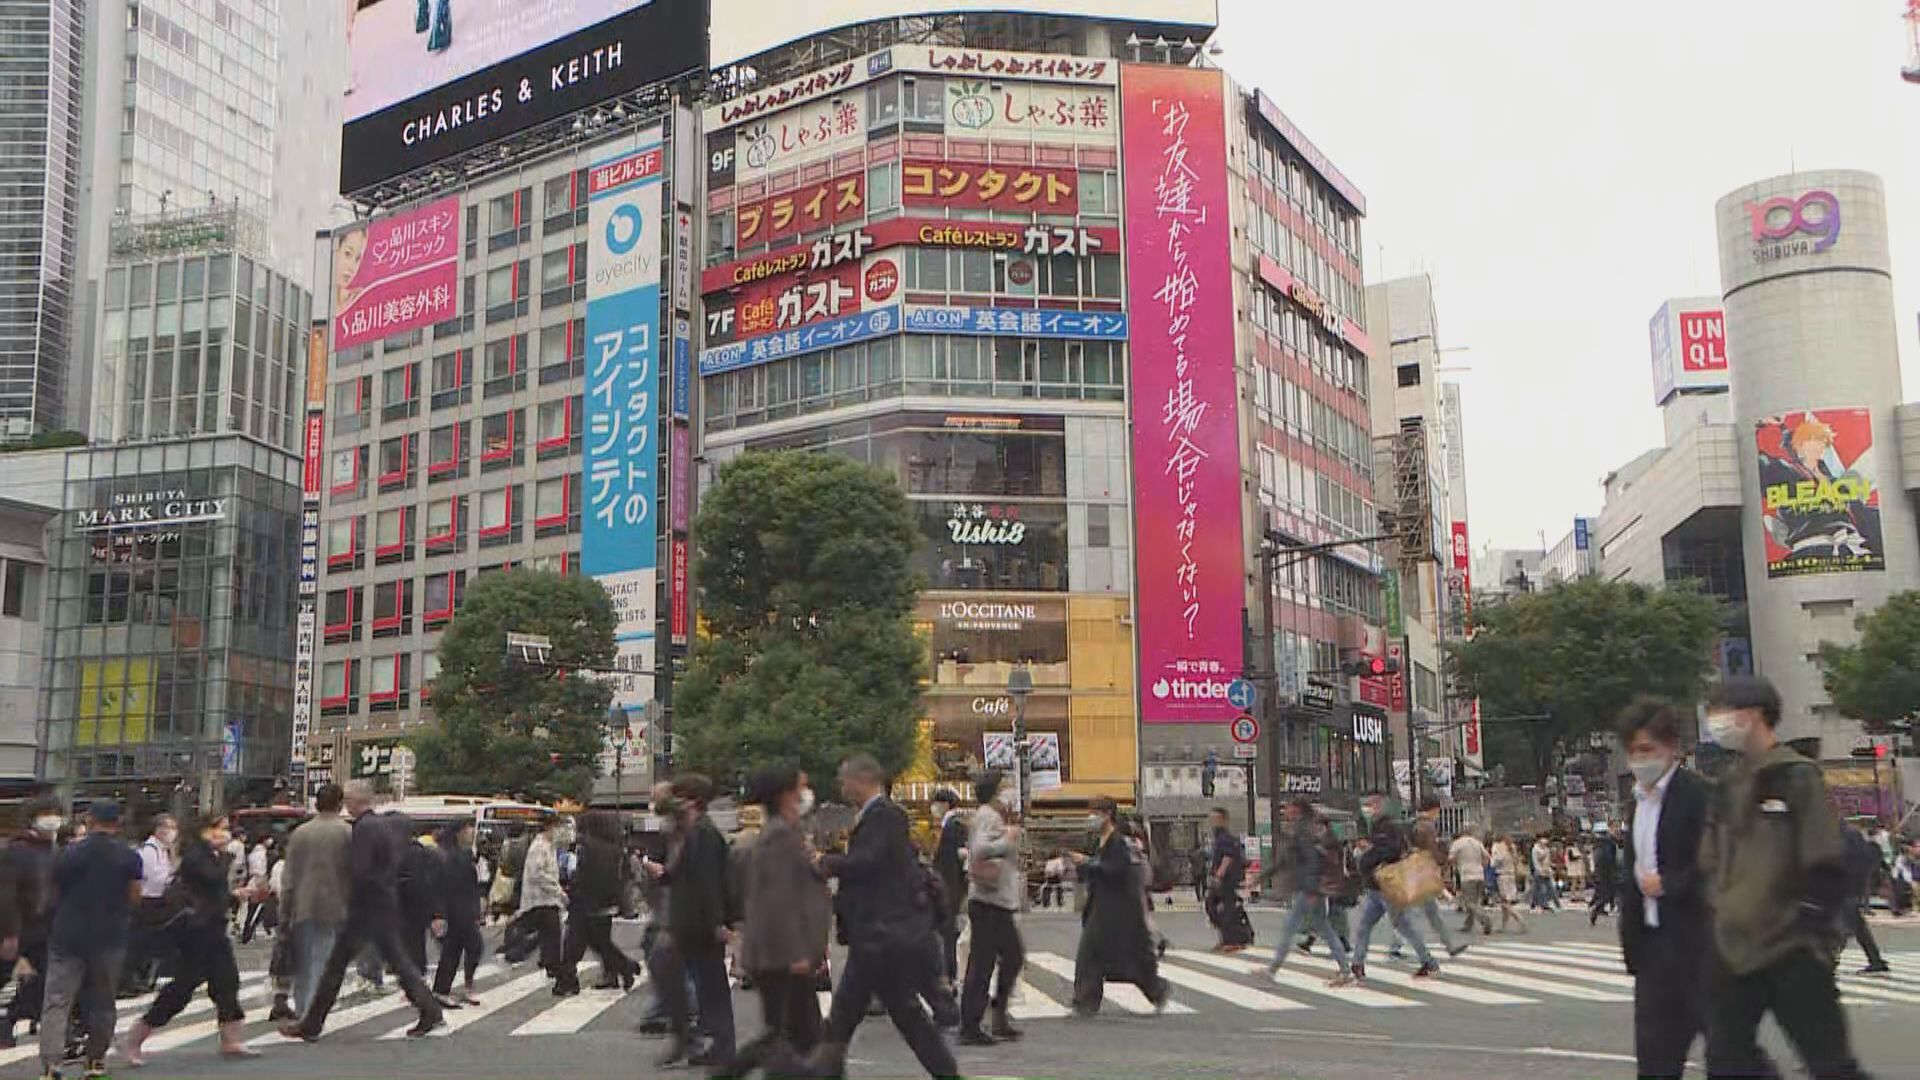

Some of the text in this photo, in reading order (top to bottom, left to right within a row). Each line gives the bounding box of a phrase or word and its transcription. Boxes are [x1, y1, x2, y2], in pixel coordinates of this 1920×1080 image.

[402, 41, 624, 146] CHARLES & KEITH
[781, 102, 858, 153] しゃぶ葉
[1005, 93, 1109, 129] しゃぶ葉
[711, 148, 734, 171] 9F
[903, 166, 1072, 203] コンタクト
[740, 179, 861, 239] プライス
[1744, 190, 1841, 254] 109
[389, 211, 453, 248] 品川スキン
[1023, 224, 1101, 257] ガスト
[389, 235, 445, 269] クリニック
[811, 228, 873, 270] ガスト
[1752, 241, 1809, 264] SHIBUYA
[595, 255, 650, 286] eyecity
[351, 284, 450, 336] 品川美容外科
[742, 293, 774, 321] Café
[777, 278, 854, 328] ガスト
[912, 309, 963, 327] AEON
[708, 308, 736, 336] 7F
[1687, 318, 1723, 341] UN
[706, 346, 740, 365] AEON
[1689, 342, 1725, 368] QL
[591, 329, 623, 529] アイシティ
[625, 323, 649, 525] コンタクトの
[114, 488, 185, 505] SHIBUYA
[1766, 475, 1872, 510] BLEACH
[78, 499, 226, 526] MARK CITY
[1171, 677, 1231, 698] tinder
[971, 697, 1009, 714] Café
[1353, 714, 1382, 744] LUSH
